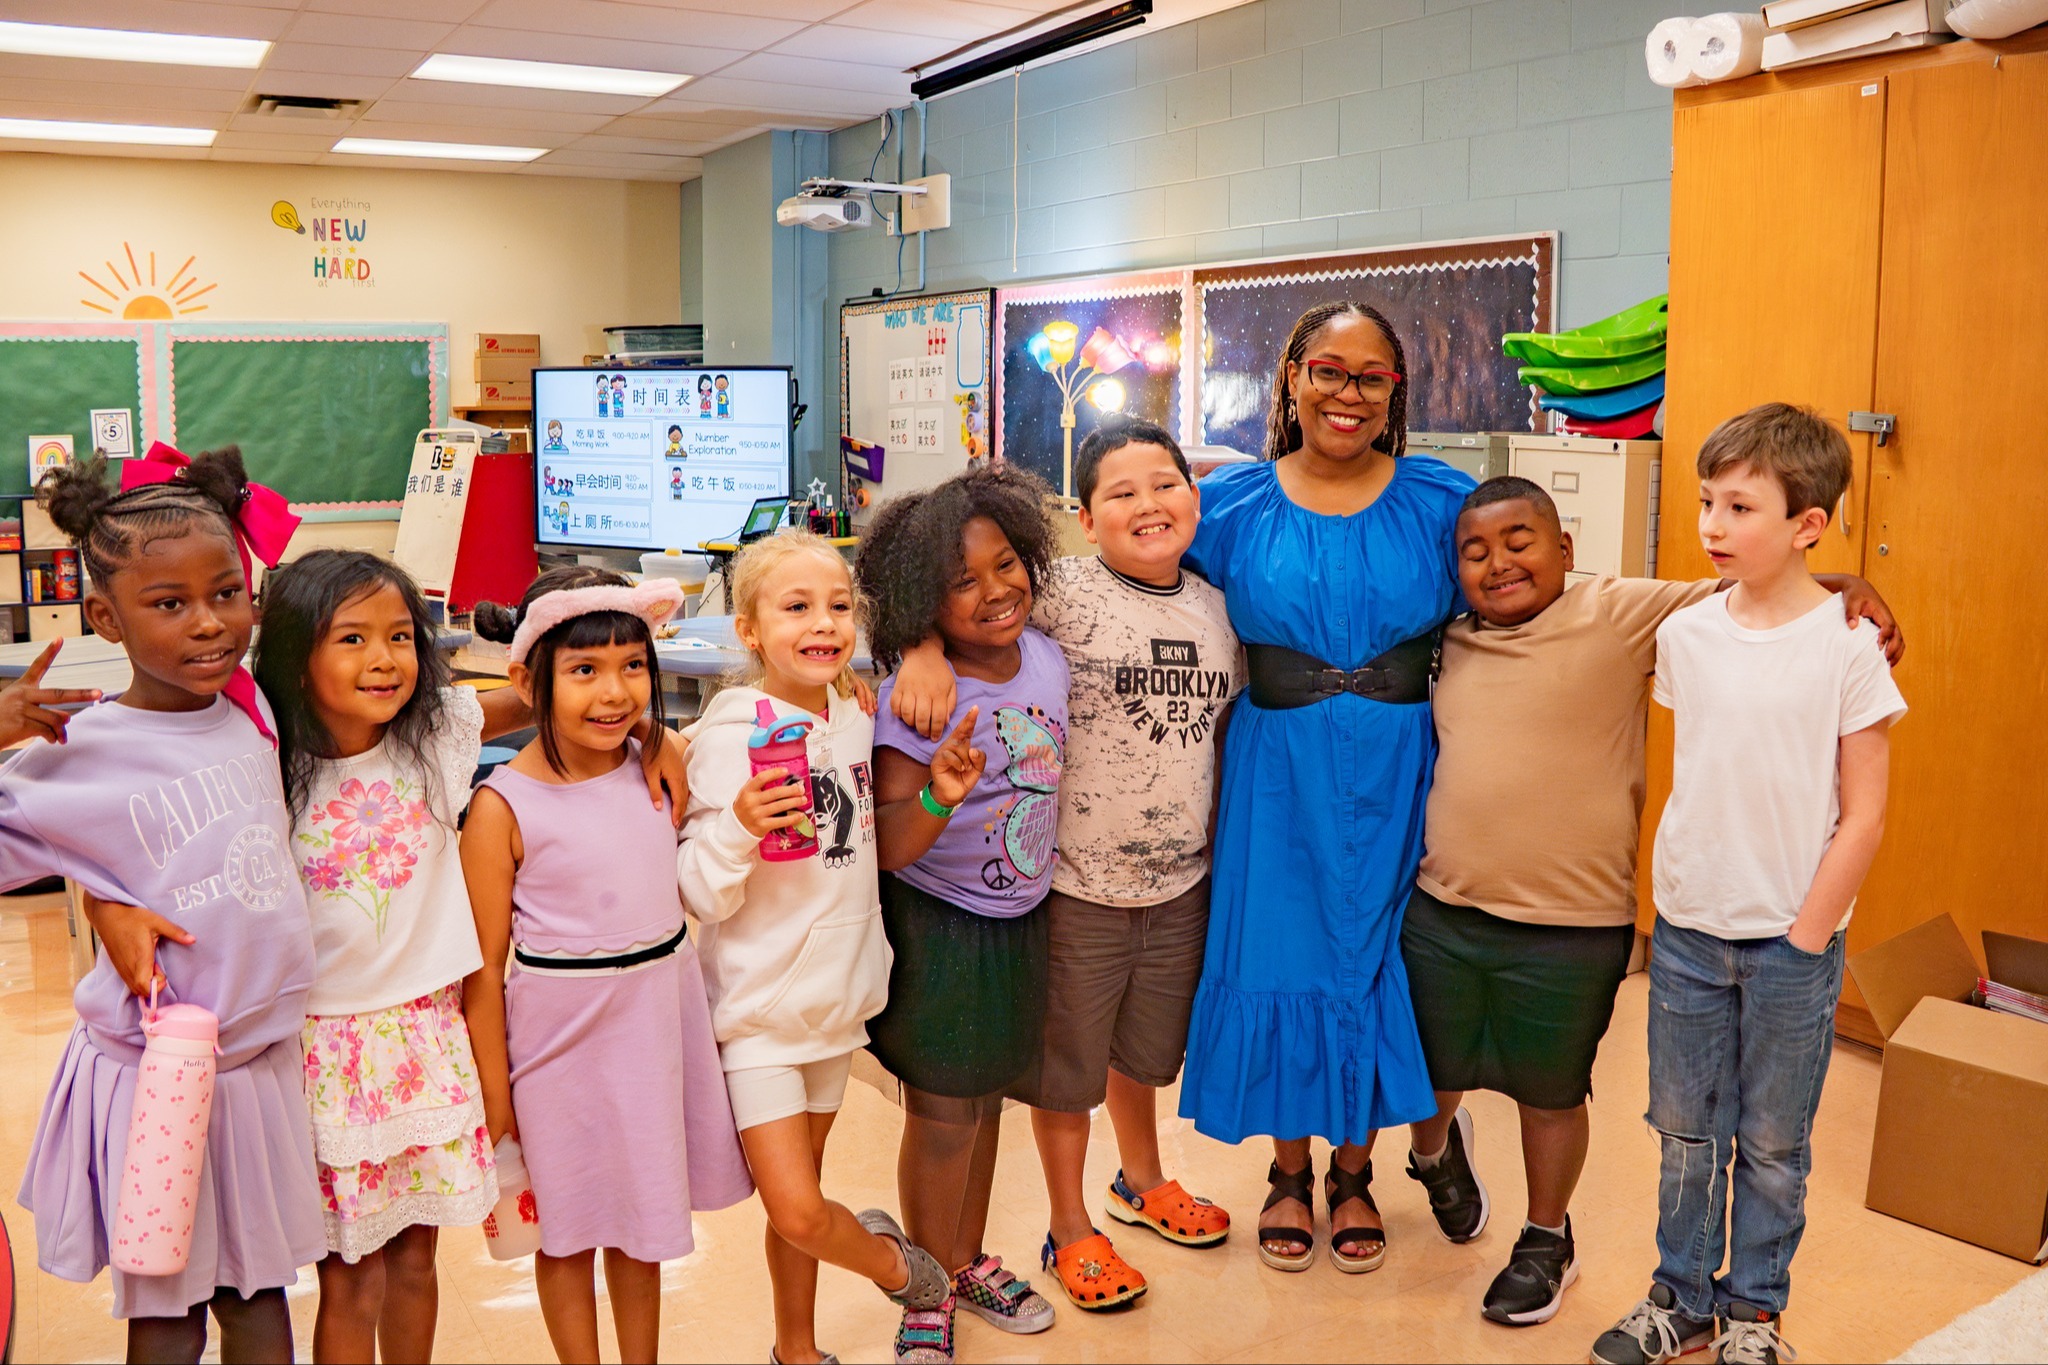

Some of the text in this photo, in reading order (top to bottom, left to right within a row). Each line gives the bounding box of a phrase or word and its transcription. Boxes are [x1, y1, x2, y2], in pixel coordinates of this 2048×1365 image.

[311, 198, 371, 212] Everything
[313, 218, 366, 241] NEW
[333, 244, 342, 255] is
[314, 257, 370, 280] HARD
[885, 301, 954, 329] WHO WE ARE
[633, 387, 690, 406] 时间表
[640, 432, 650, 440] AM
[695, 432, 730, 443] Number
[689, 444, 737, 456] Exploration
[770, 441, 780, 450] AM
[407, 474, 464, 498] 我们是谁
[575, 474, 622, 490] 早会时间
[692, 476, 735, 491] 吃午饭
[570, 513, 612, 530] 上厕所
[1159, 645, 1189, 661] BKNY
[1115, 666, 1229, 699] BROOKLYN
[1167, 700, 1189, 723] 23
[1123, 698, 1215, 749] NEW YORK
